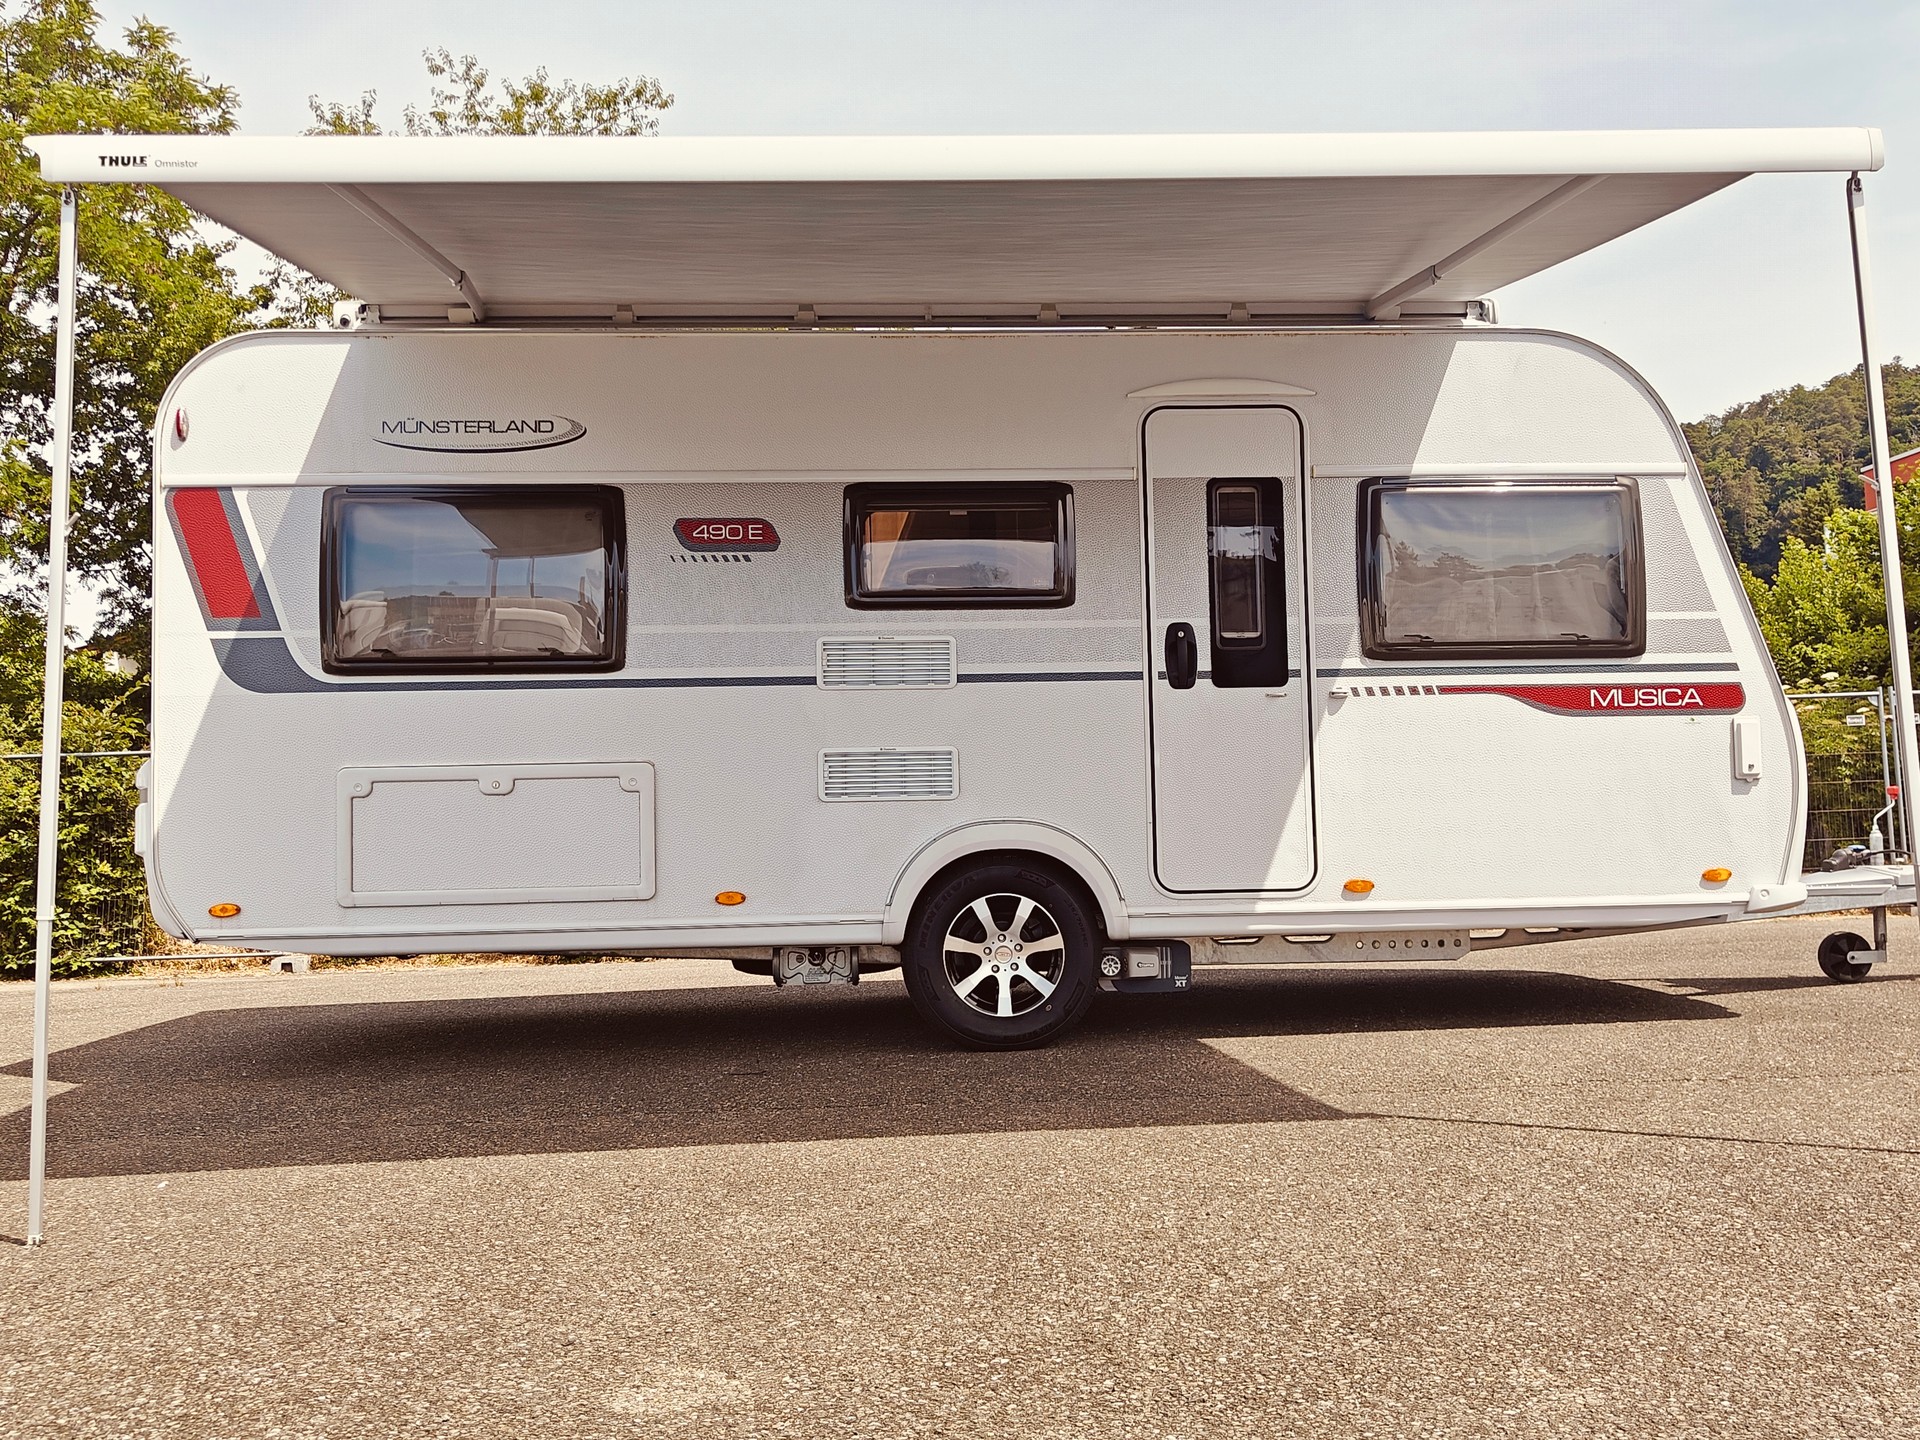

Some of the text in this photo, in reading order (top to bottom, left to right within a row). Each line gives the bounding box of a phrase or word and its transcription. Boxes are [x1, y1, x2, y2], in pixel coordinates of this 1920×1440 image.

[98, 155, 198, 168] THULE Omnistor
[381, 416, 555, 435] MÜNSTERLAND
[692, 524, 763, 540] 490 E
[1589, 688, 1704, 707] MUSICA
[1174, 980, 1188, 988] XT
